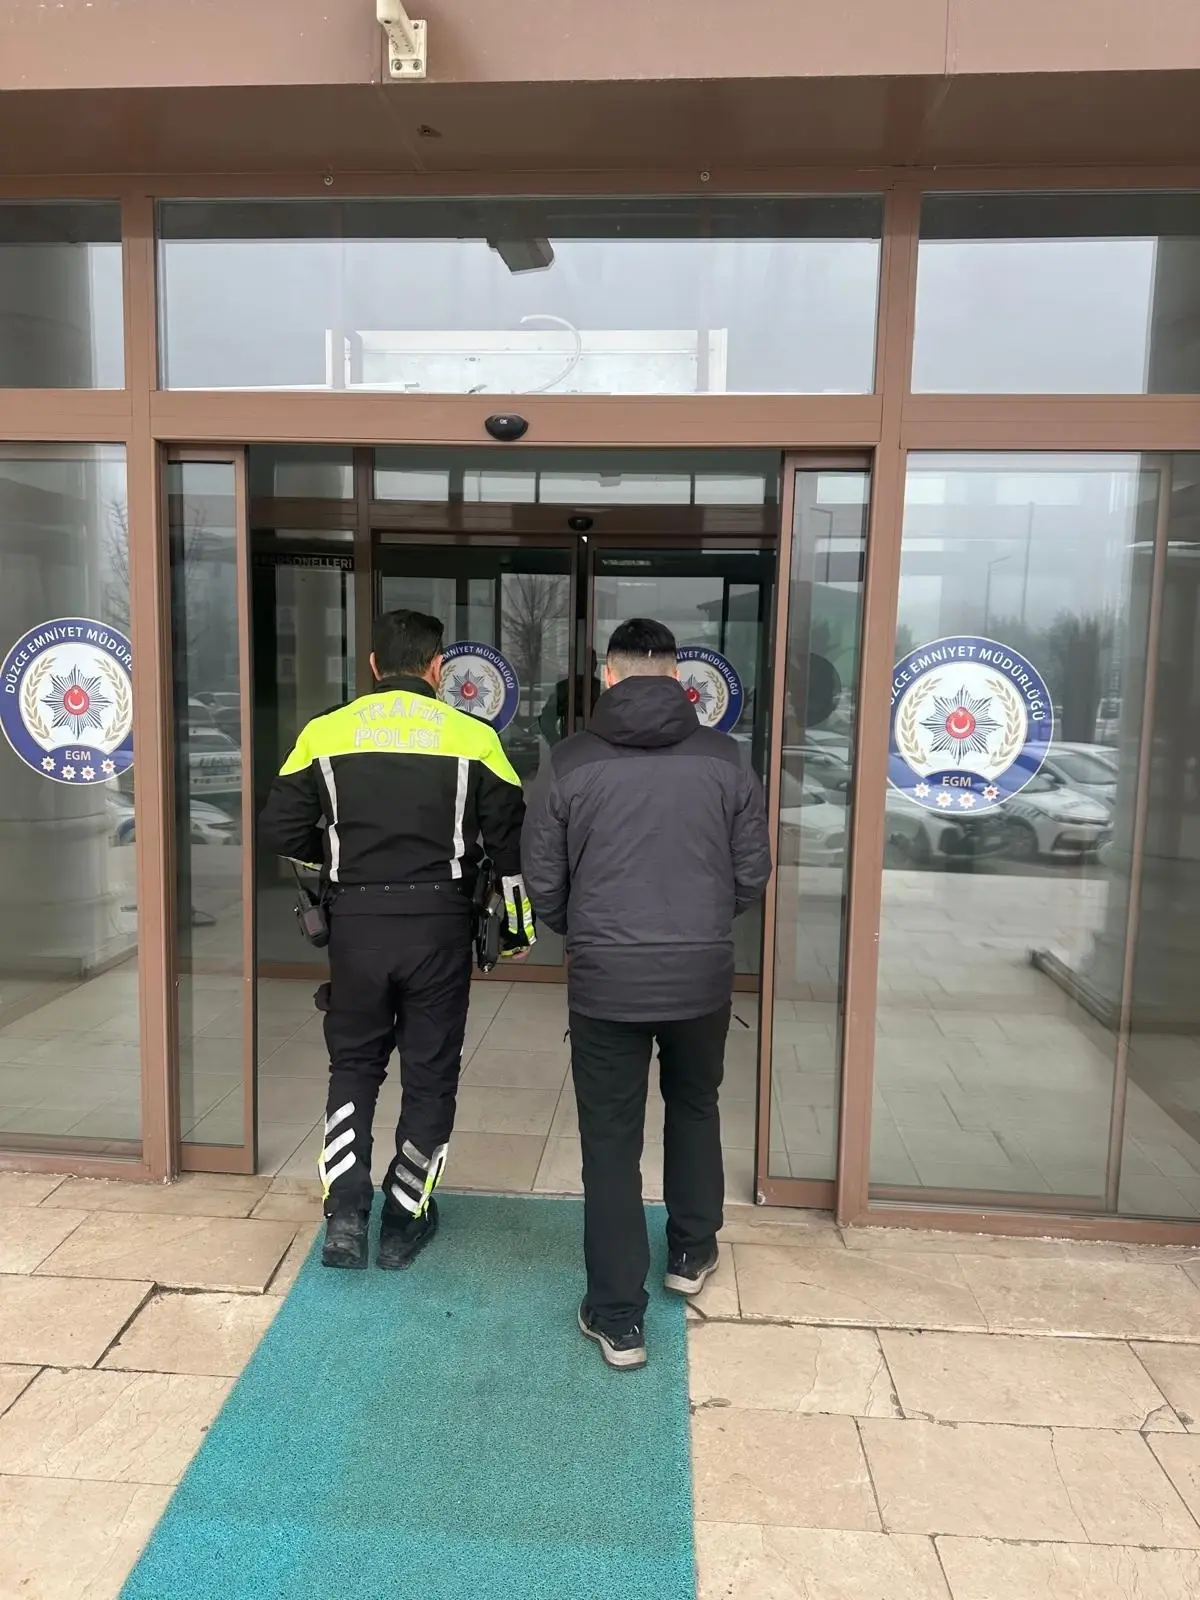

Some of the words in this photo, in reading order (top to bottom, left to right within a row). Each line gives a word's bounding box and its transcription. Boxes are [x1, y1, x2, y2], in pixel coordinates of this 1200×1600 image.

[5, 654, 30, 694] DÜZCE
[29, 626, 83, 653] EMNİYET
[909, 646, 976, 674] EMNİYET
[979, 648, 1046, 721] MÜDÜRLÜĞÜ
[65, 750, 92, 761] EGM
[942, 775, 972, 787] EGM
